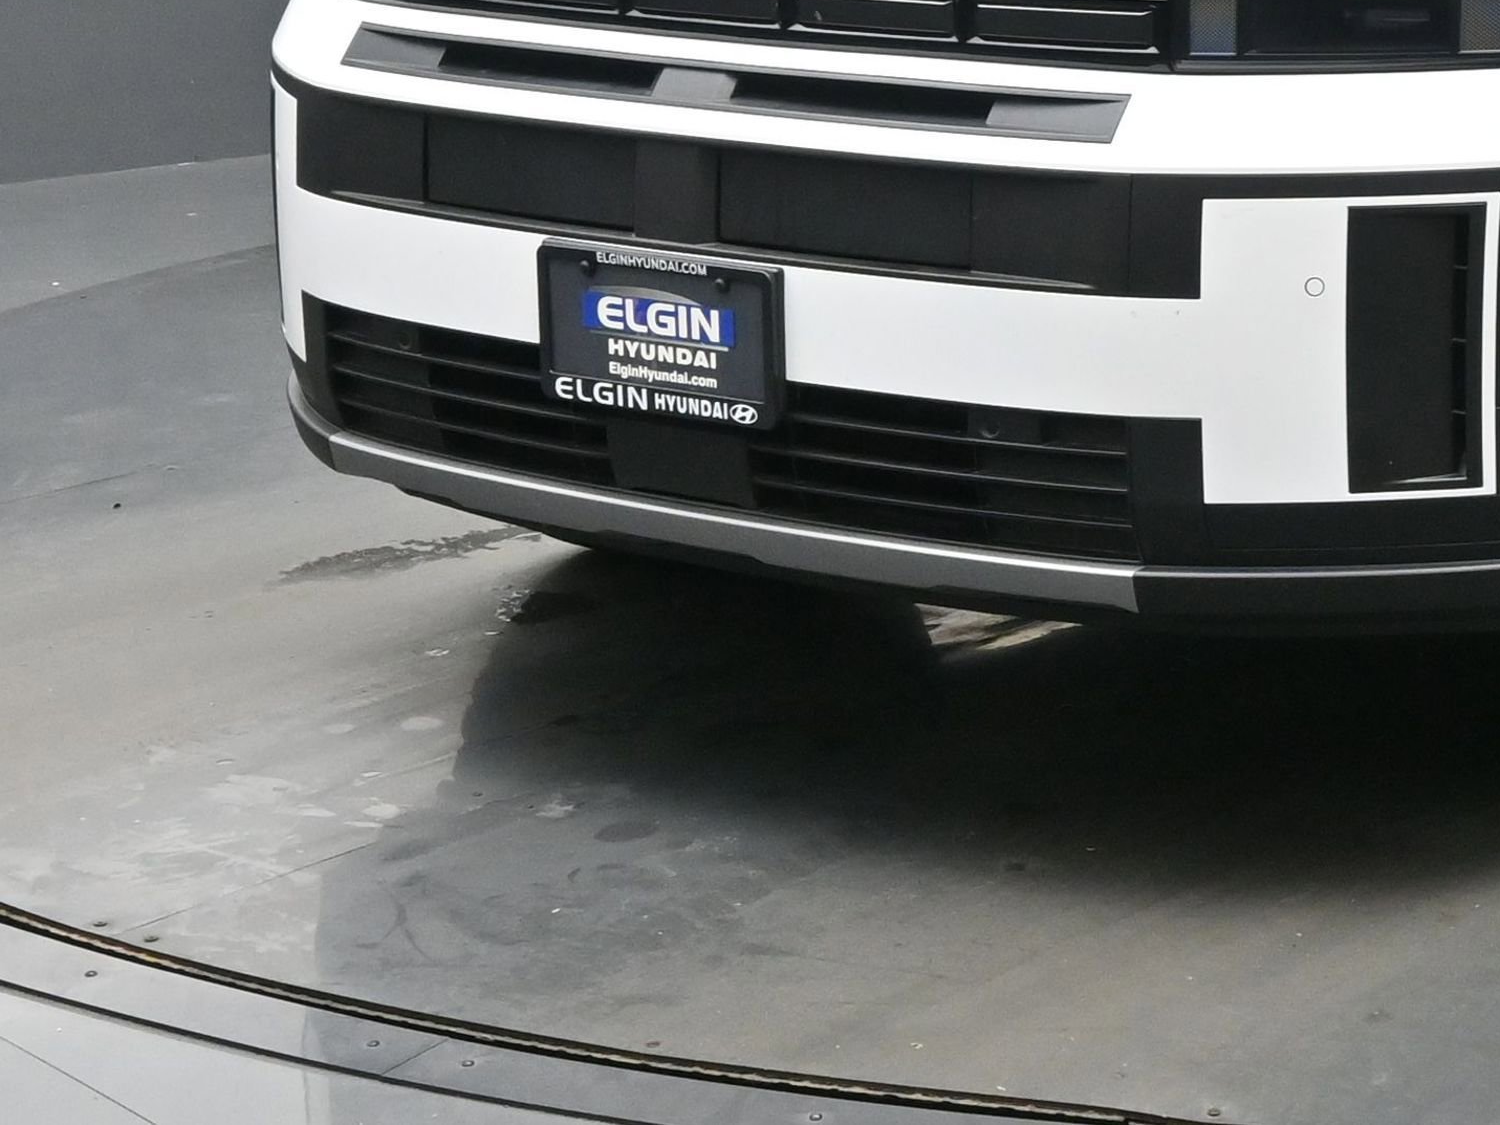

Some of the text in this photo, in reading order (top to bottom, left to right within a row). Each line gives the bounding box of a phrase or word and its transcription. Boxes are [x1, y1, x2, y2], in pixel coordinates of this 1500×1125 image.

[596, 251, 707, 277] ELGINHYUNDAI.COM
[596, 295, 721, 343] ELGIN
[608, 337, 717, 369] HYUNDAI
[608, 361, 718, 389] ElginHyundai.com
[555, 377, 729, 420] ELGIN HYUNDAI
